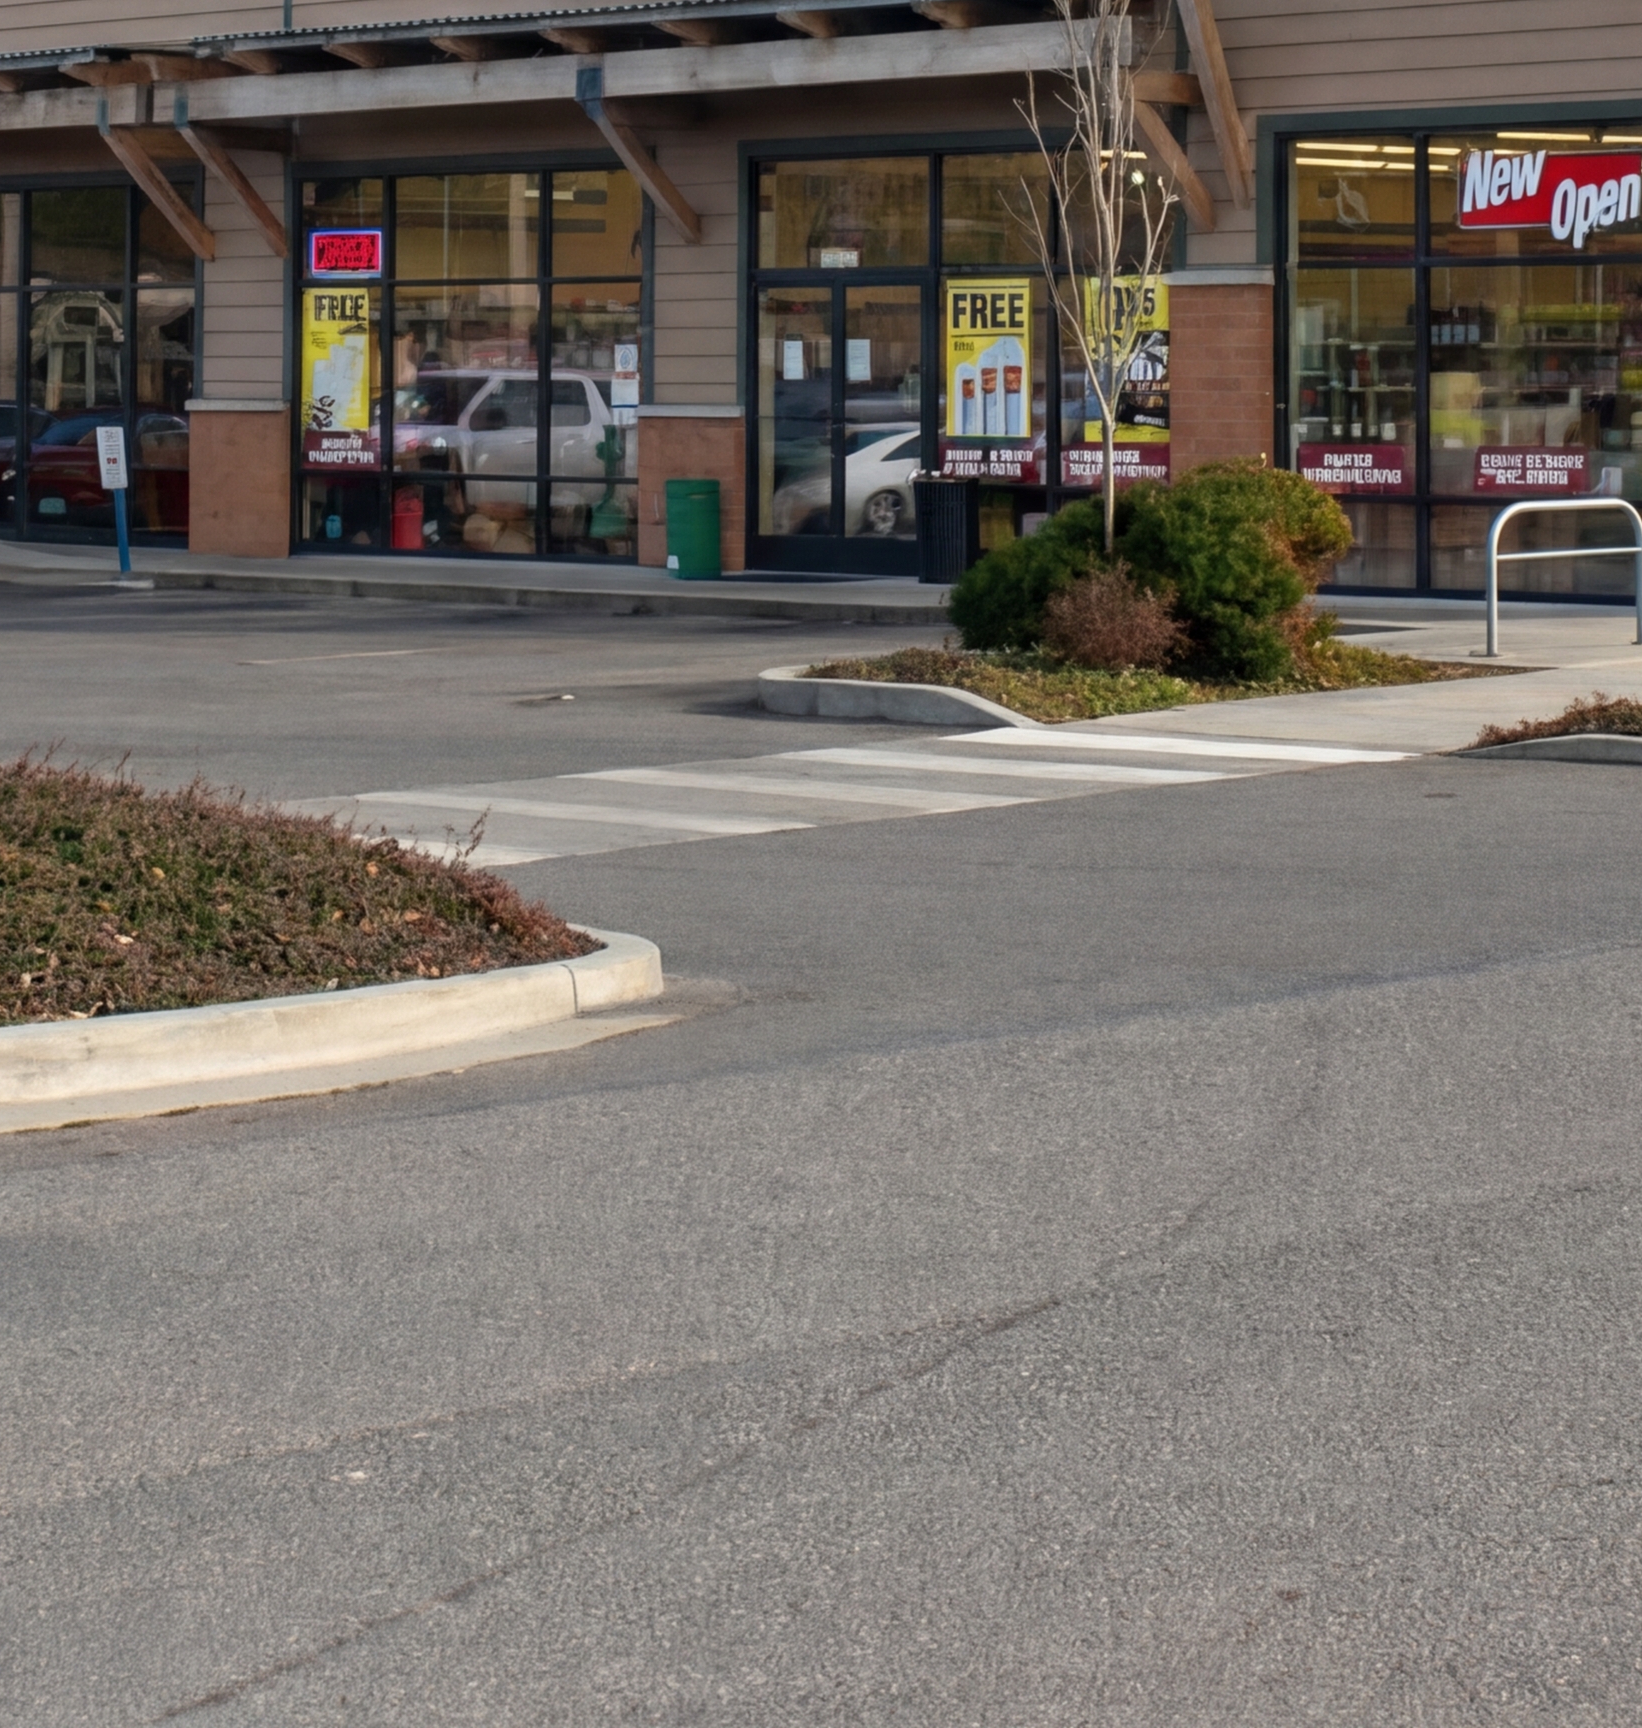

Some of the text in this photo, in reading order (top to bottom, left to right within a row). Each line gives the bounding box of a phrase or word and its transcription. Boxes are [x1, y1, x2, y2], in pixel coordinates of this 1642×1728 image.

[1462, 149, 1547, 213] New
[1551, 173, 1642, 249] Open
[952, 293, 1025, 329] FREE
